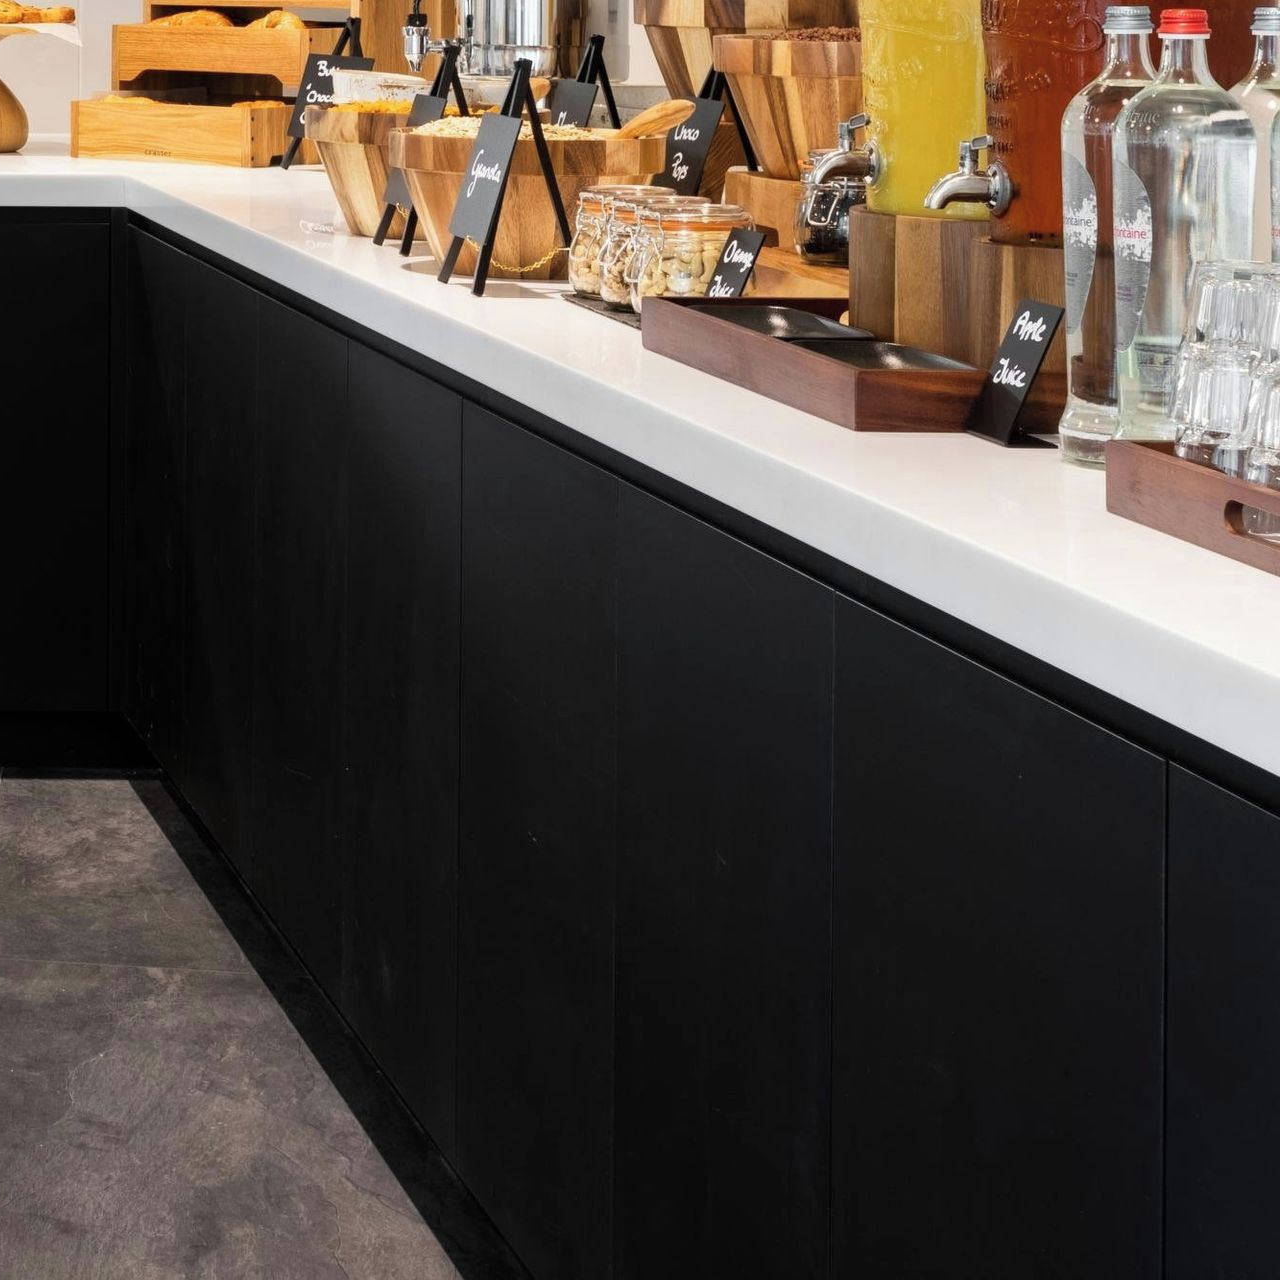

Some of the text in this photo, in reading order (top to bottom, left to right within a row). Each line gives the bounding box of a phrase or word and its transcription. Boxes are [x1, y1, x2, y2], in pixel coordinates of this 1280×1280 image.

[723, 240, 754, 273] Orange
[1012, 310, 1047, 342] Apple
[992, 358, 1026, 387] Juice
